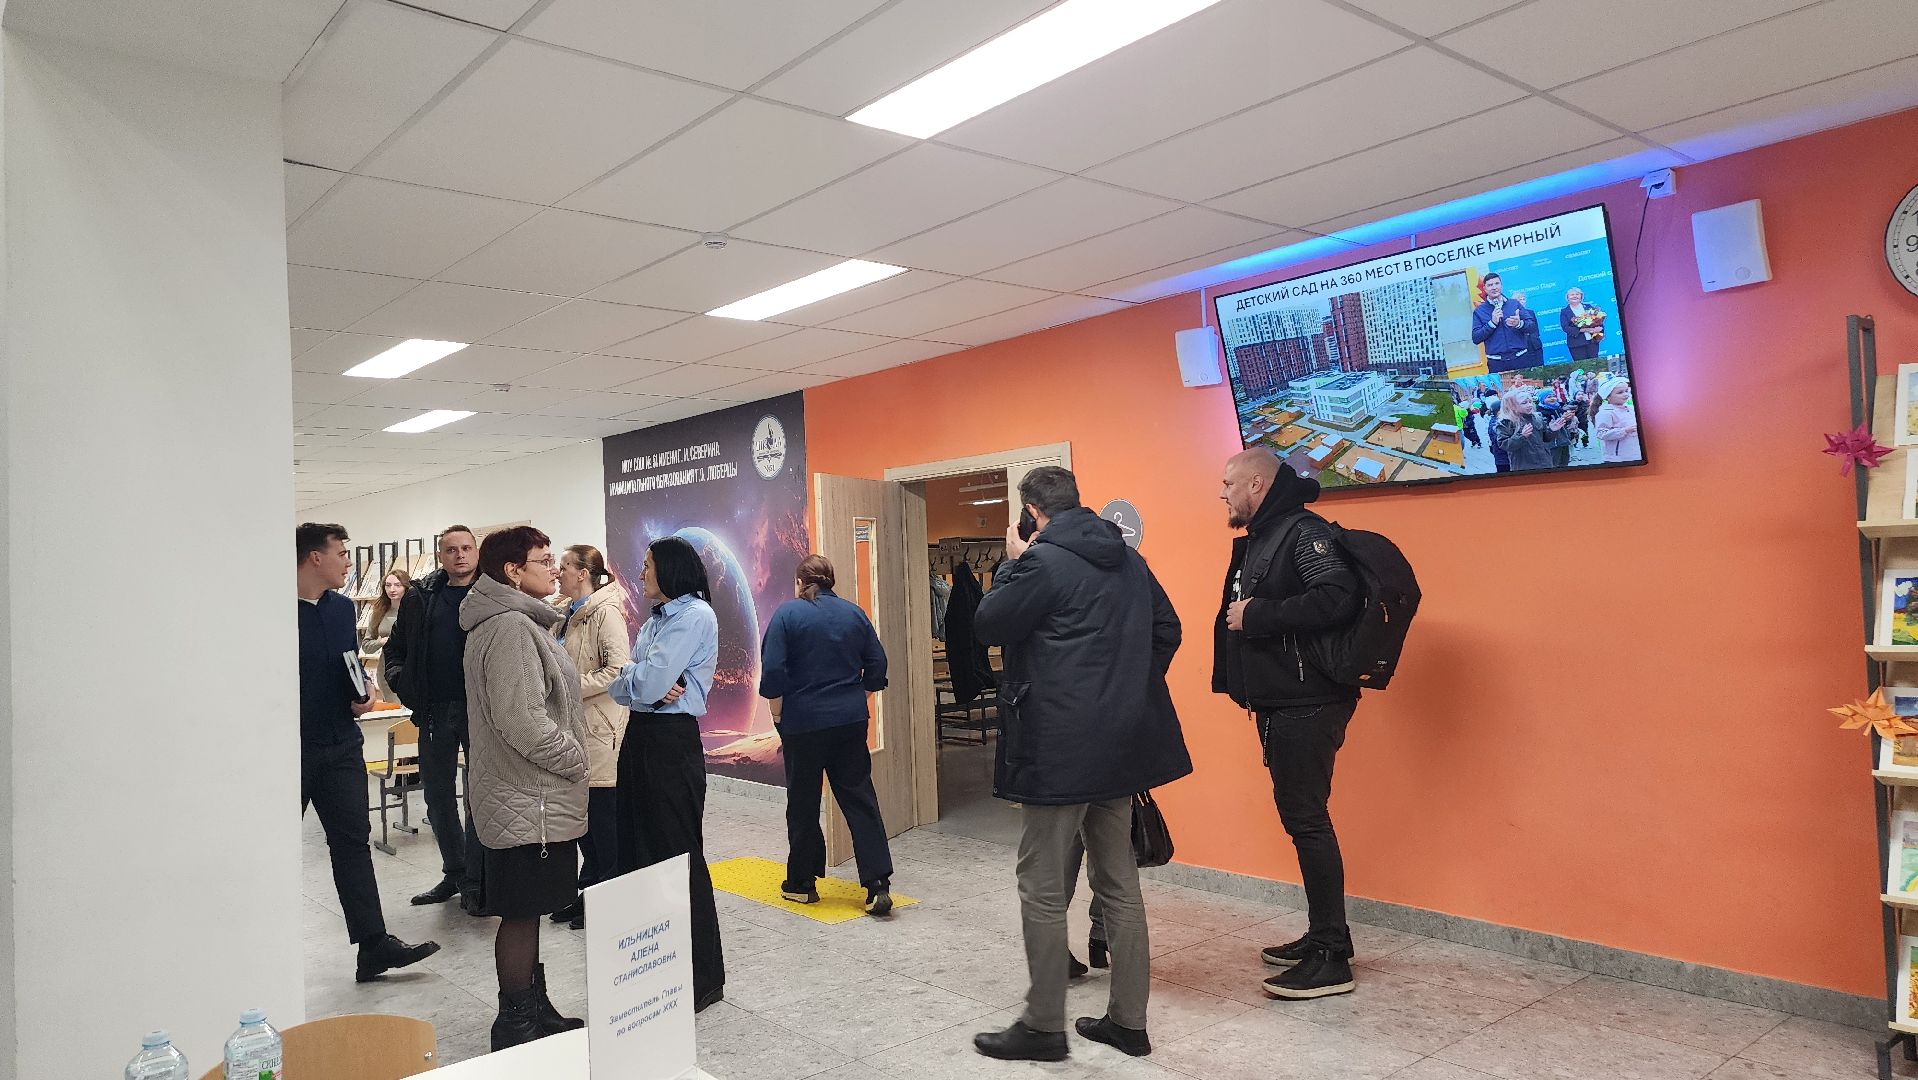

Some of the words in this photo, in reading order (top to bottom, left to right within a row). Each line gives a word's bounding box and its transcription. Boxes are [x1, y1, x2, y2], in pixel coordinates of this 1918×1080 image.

[1906, 234, 1918, 252] 9
[1236, 286, 1290, 312] ДЕТСКИЙ
[1292, 282, 1319, 297] САД
[1320, 277, 1338, 291] НА
[1340, 272, 1362, 286] 360
[1365, 262, 1401, 281] МЕСТ
[1404, 260, 1413, 272] В
[1416, 243, 1485, 268] ПОСЕЛКЕ
[1488, 222, 1561, 253] МИРНЫЙ
[706, 461, 738, 482] ЛЮБЕРЦЫ
[618, 919, 670, 950] ИЛЬНИЦКАЯ
[613, 950, 677, 987] СТАНИСЛАВОВНА
[630, 941, 660, 963] АЛЕНА
[609, 995, 659, 1025] Заместитель
[661, 984, 683, 1000] Главы
[616, 1027, 626, 1038] по
[627, 1008, 661, 1031] вопросам
[663, 998, 678, 1014] ЖКХ
